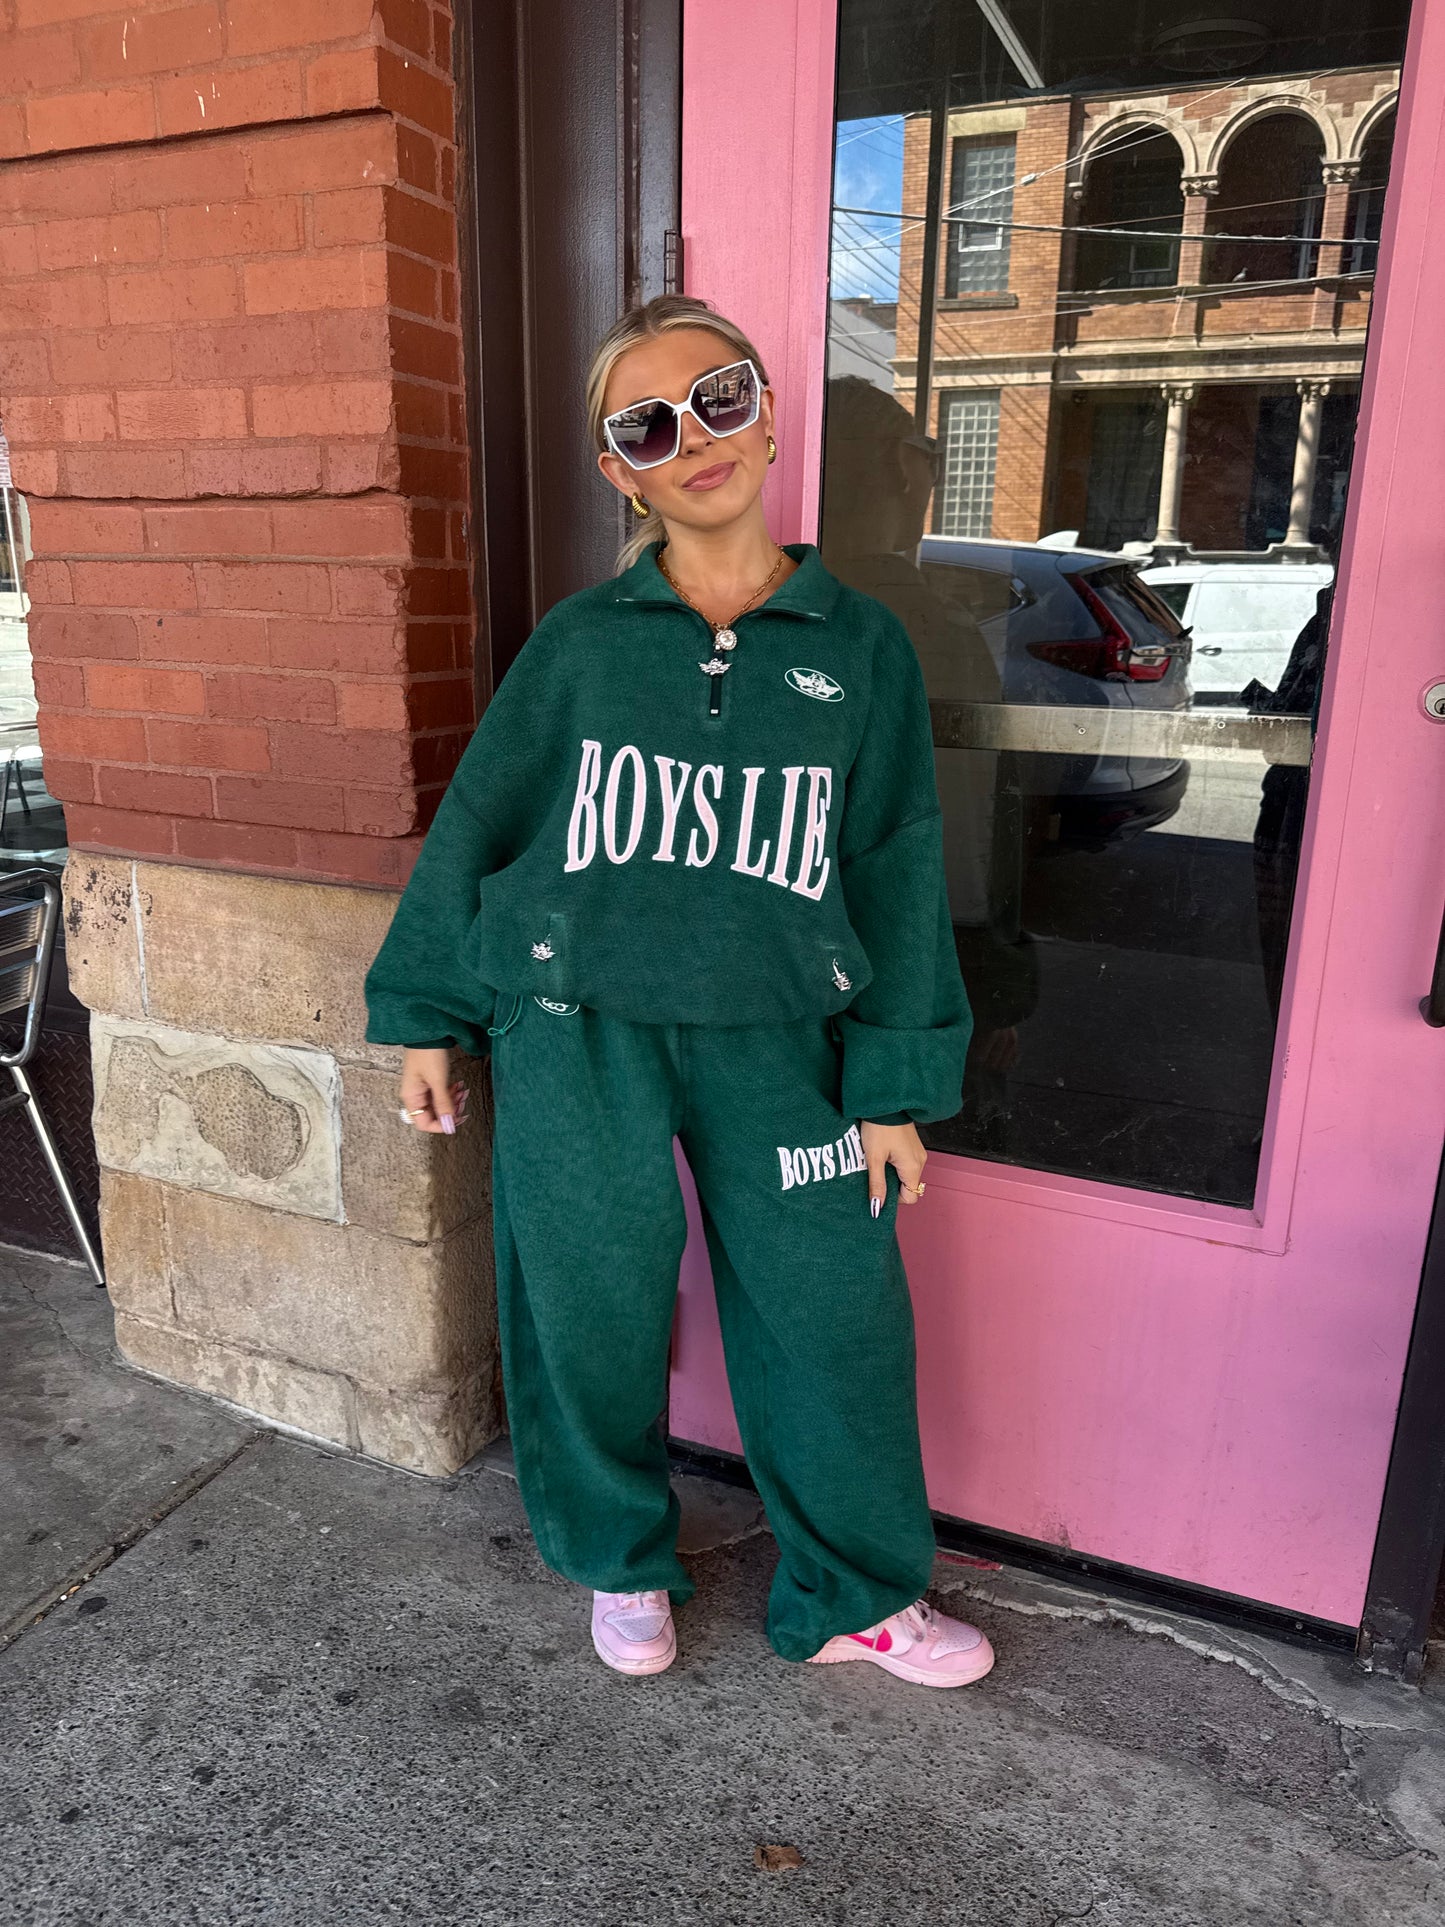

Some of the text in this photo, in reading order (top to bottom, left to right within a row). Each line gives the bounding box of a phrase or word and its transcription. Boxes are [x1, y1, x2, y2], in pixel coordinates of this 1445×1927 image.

[564, 739, 832, 901] BOYS LIE
[777, 1143, 836, 1191] BOYS
